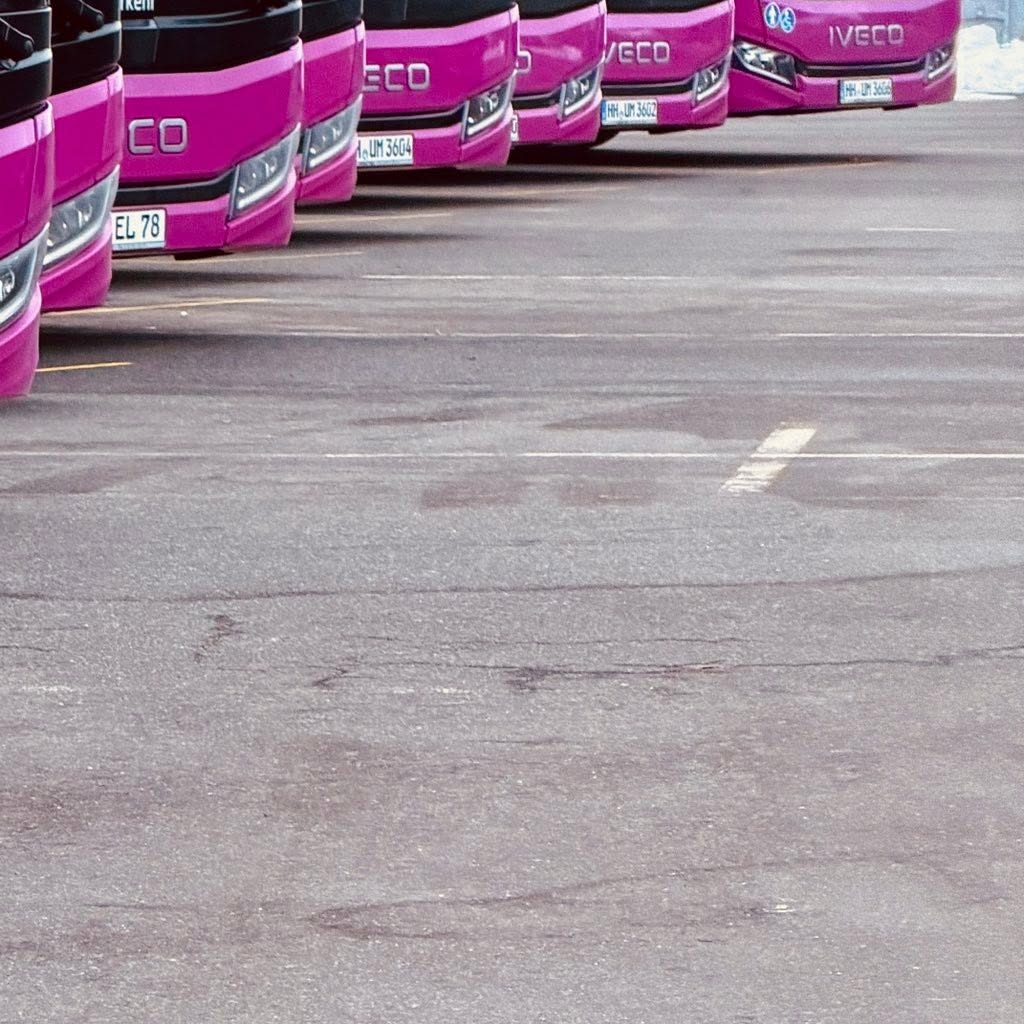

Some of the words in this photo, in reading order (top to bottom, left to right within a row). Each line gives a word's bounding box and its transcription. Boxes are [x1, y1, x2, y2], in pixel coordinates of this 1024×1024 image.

[828, 23, 905, 48] IVECO
[607, 102, 619, 118] HH
[624, 101, 636, 118] UM
[636, 100, 657, 117] 3602
[128, 117, 188, 154] CO
[369, 138, 384, 158] UM
[385, 136, 412, 158] 3604
[115, 216, 135, 240] EL
[141, 213, 160, 238] 78
